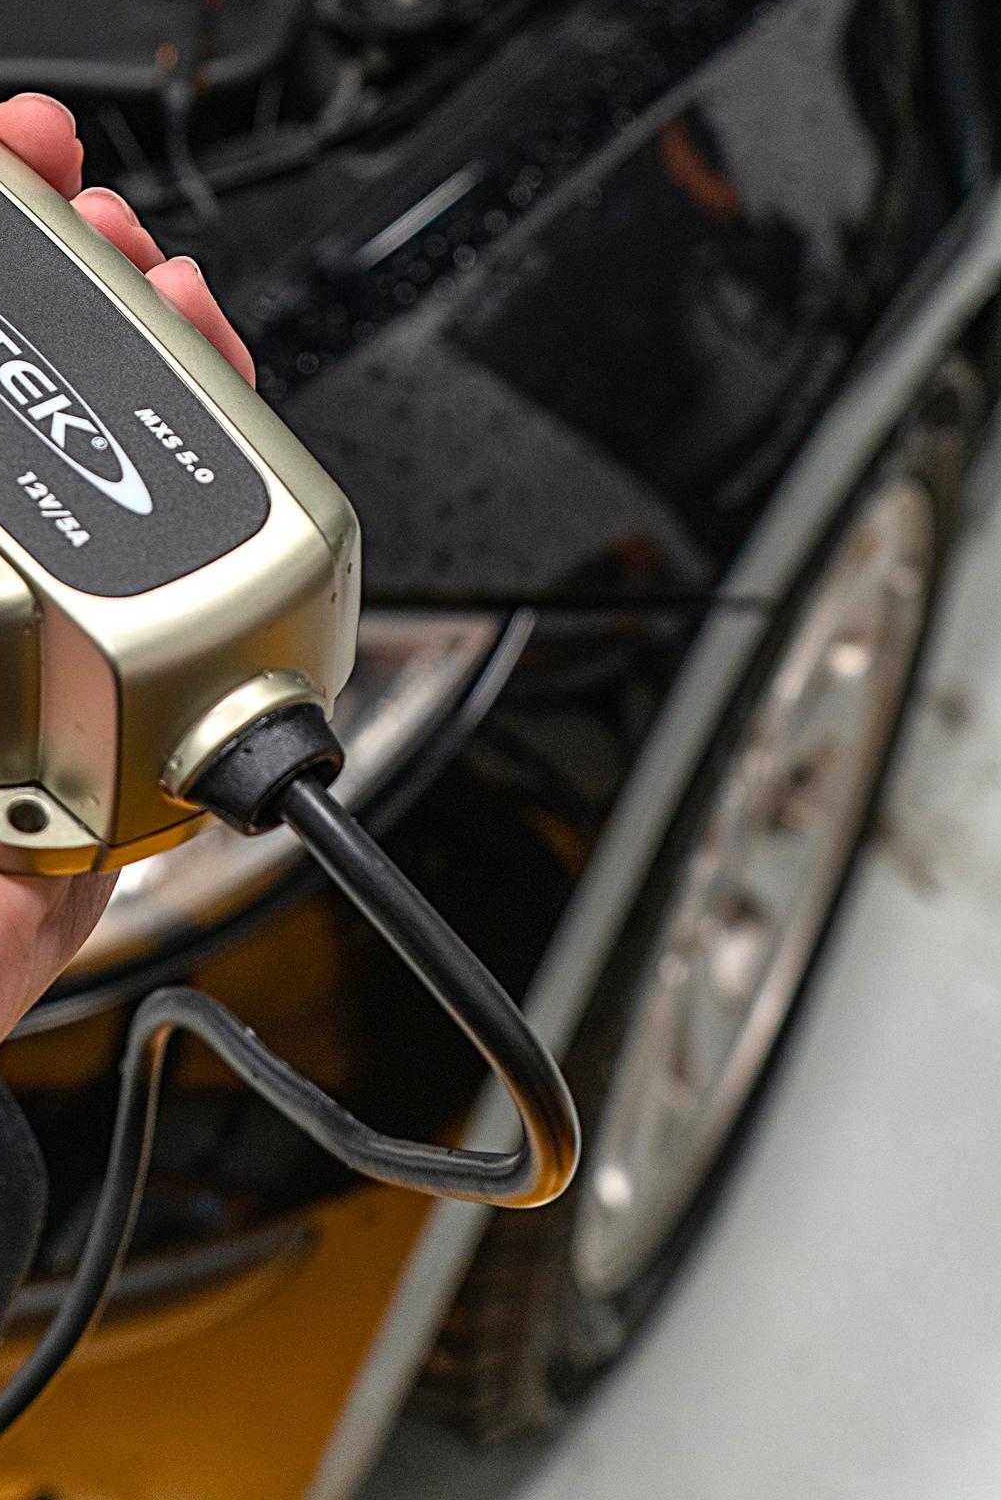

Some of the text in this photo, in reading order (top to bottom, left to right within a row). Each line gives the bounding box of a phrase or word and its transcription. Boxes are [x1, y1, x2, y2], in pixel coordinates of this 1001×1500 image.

[134, 408, 215, 484] MXS 5.0
[17, 471, 91, 548] 12V/5A
